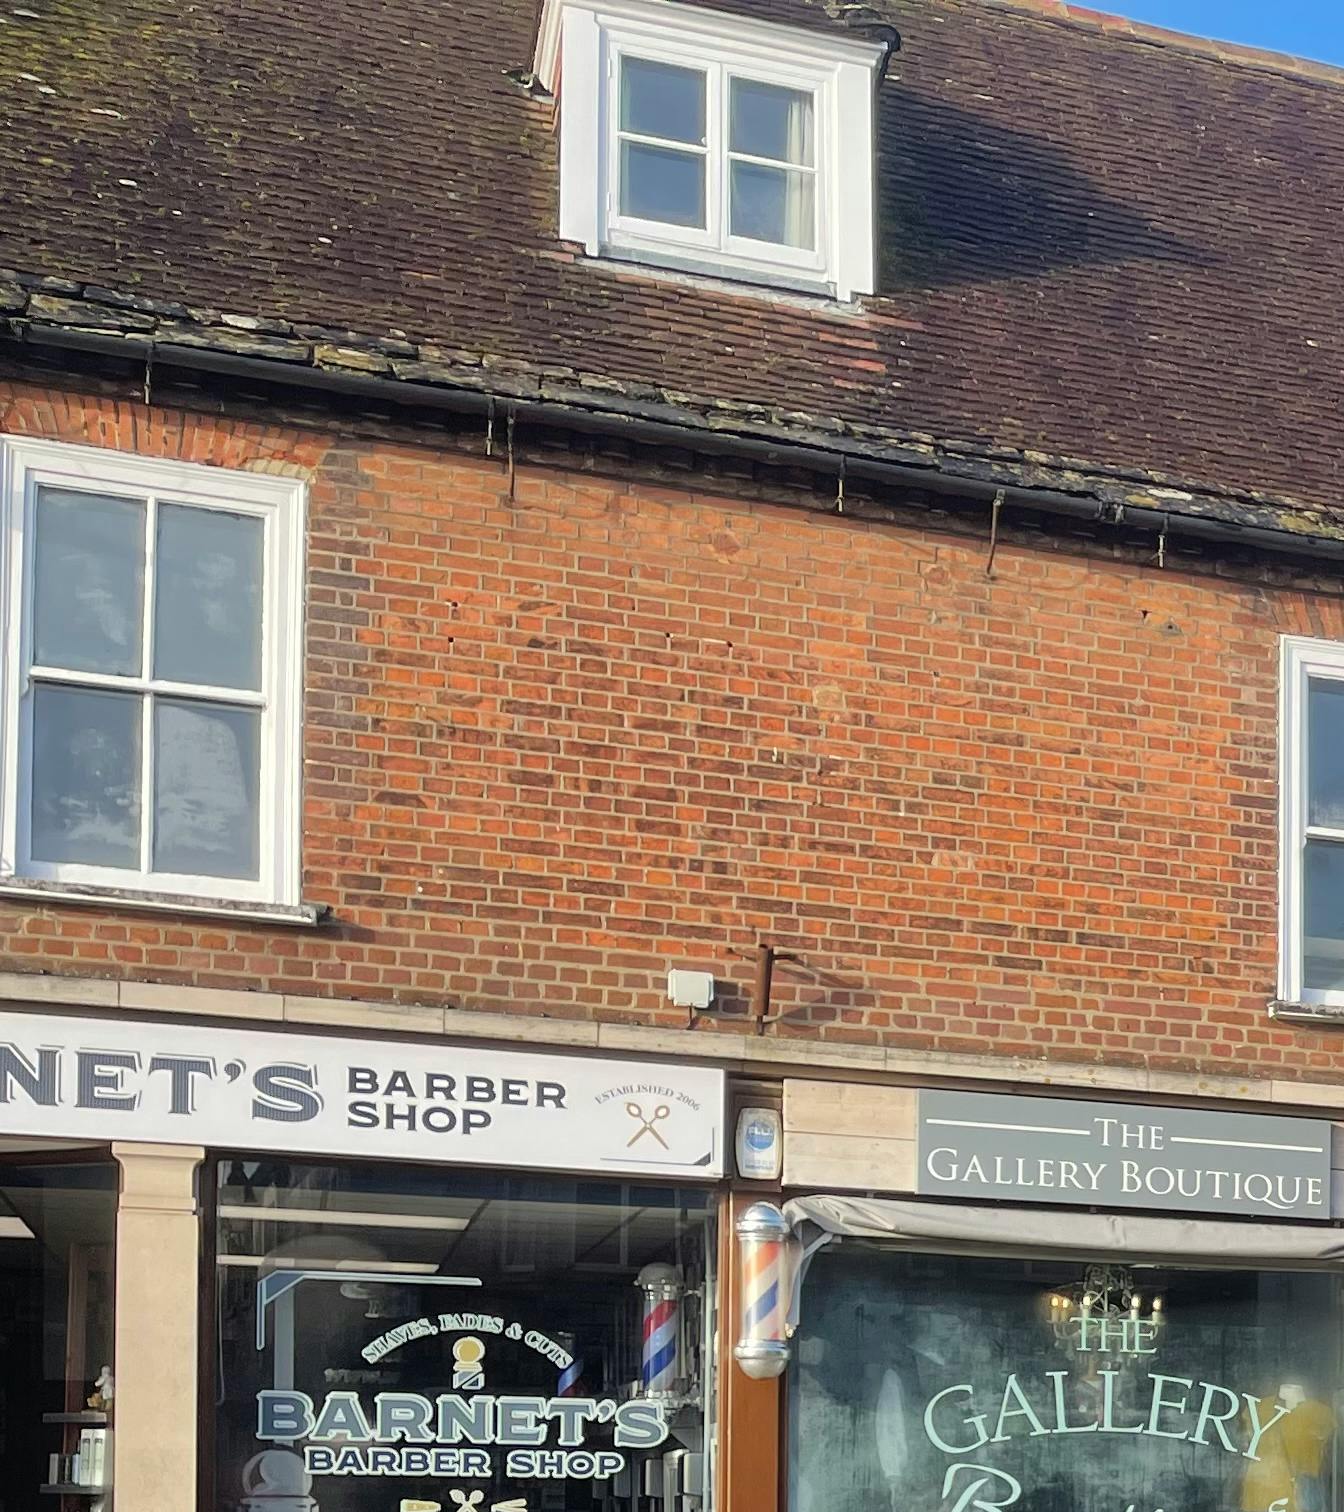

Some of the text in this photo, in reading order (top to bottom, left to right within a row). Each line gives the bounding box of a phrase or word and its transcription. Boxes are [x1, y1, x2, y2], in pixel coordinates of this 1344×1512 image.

[347, 1066, 568, 1110] BARBER
[594, 1084, 701, 1112] ESTABLISHED 2006
[347, 1100, 492, 1136] SHOP
[1094, 1117, 1165, 1151] THE
[926, 1147, 1323, 1210] GALLERY BOUTIQUE
[438, 1313, 503, 1334] FADES
[505, 1323, 523, 1340] &
[524, 1331, 574, 1369] CUTS
[1069, 1316, 1158, 1354] THE
[255, 1389, 671, 1449] BARNET'S
[923, 1370, 1291, 1462] GALLERY
[304, 1446, 626, 1480] BARBER SHOP
